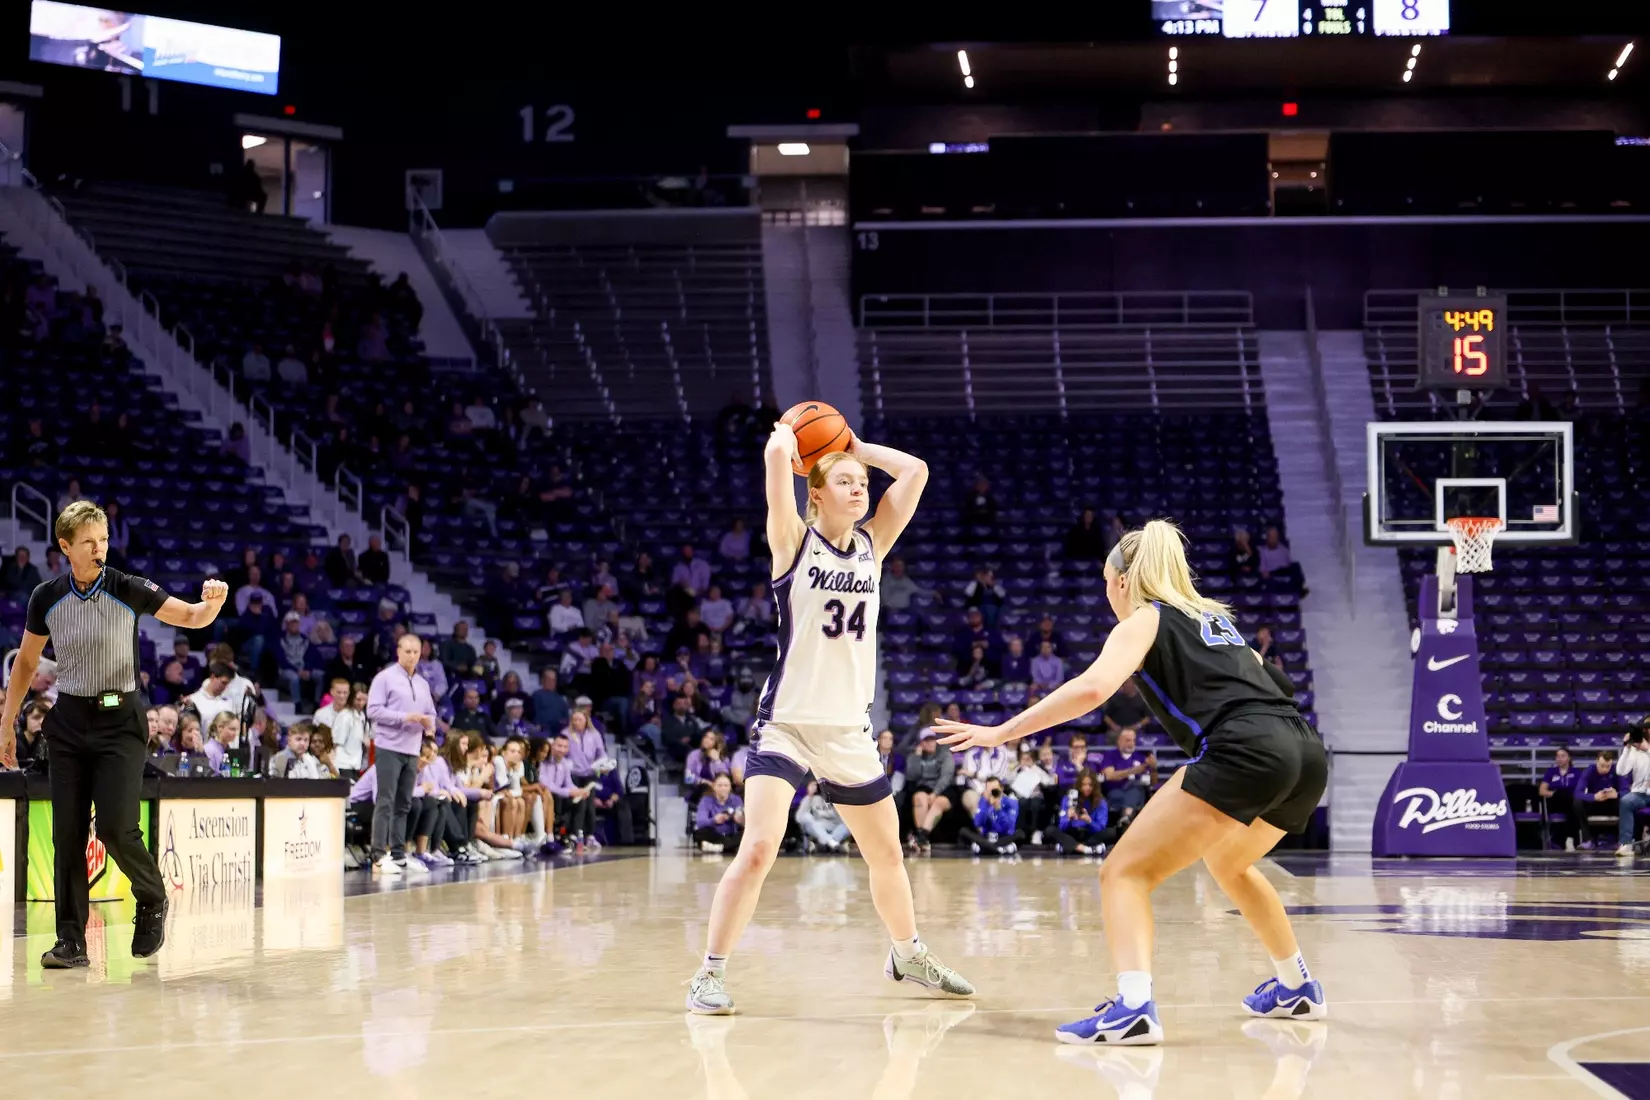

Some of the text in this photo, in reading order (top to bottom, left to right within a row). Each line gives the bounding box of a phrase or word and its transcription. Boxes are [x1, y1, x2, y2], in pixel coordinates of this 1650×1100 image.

[1401, 0, 1419, 20] 8
[1162, 20, 1220, 34] 4:13 PM
[1318, 21, 1351, 34] FOULS
[519, 104, 576, 142] 12
[858, 232, 879, 250] 13
[1444, 309, 1494, 332] 4:49
[1453, 335, 1487, 375] 15
[821, 598, 867, 641] 34
[1423, 721, 1477, 733] Channel
[1393, 787, 1507, 830] Dillons
[189, 807, 249, 839] Ascension
[189, 853, 209, 886] Via
[212, 851, 251, 885] Christi
